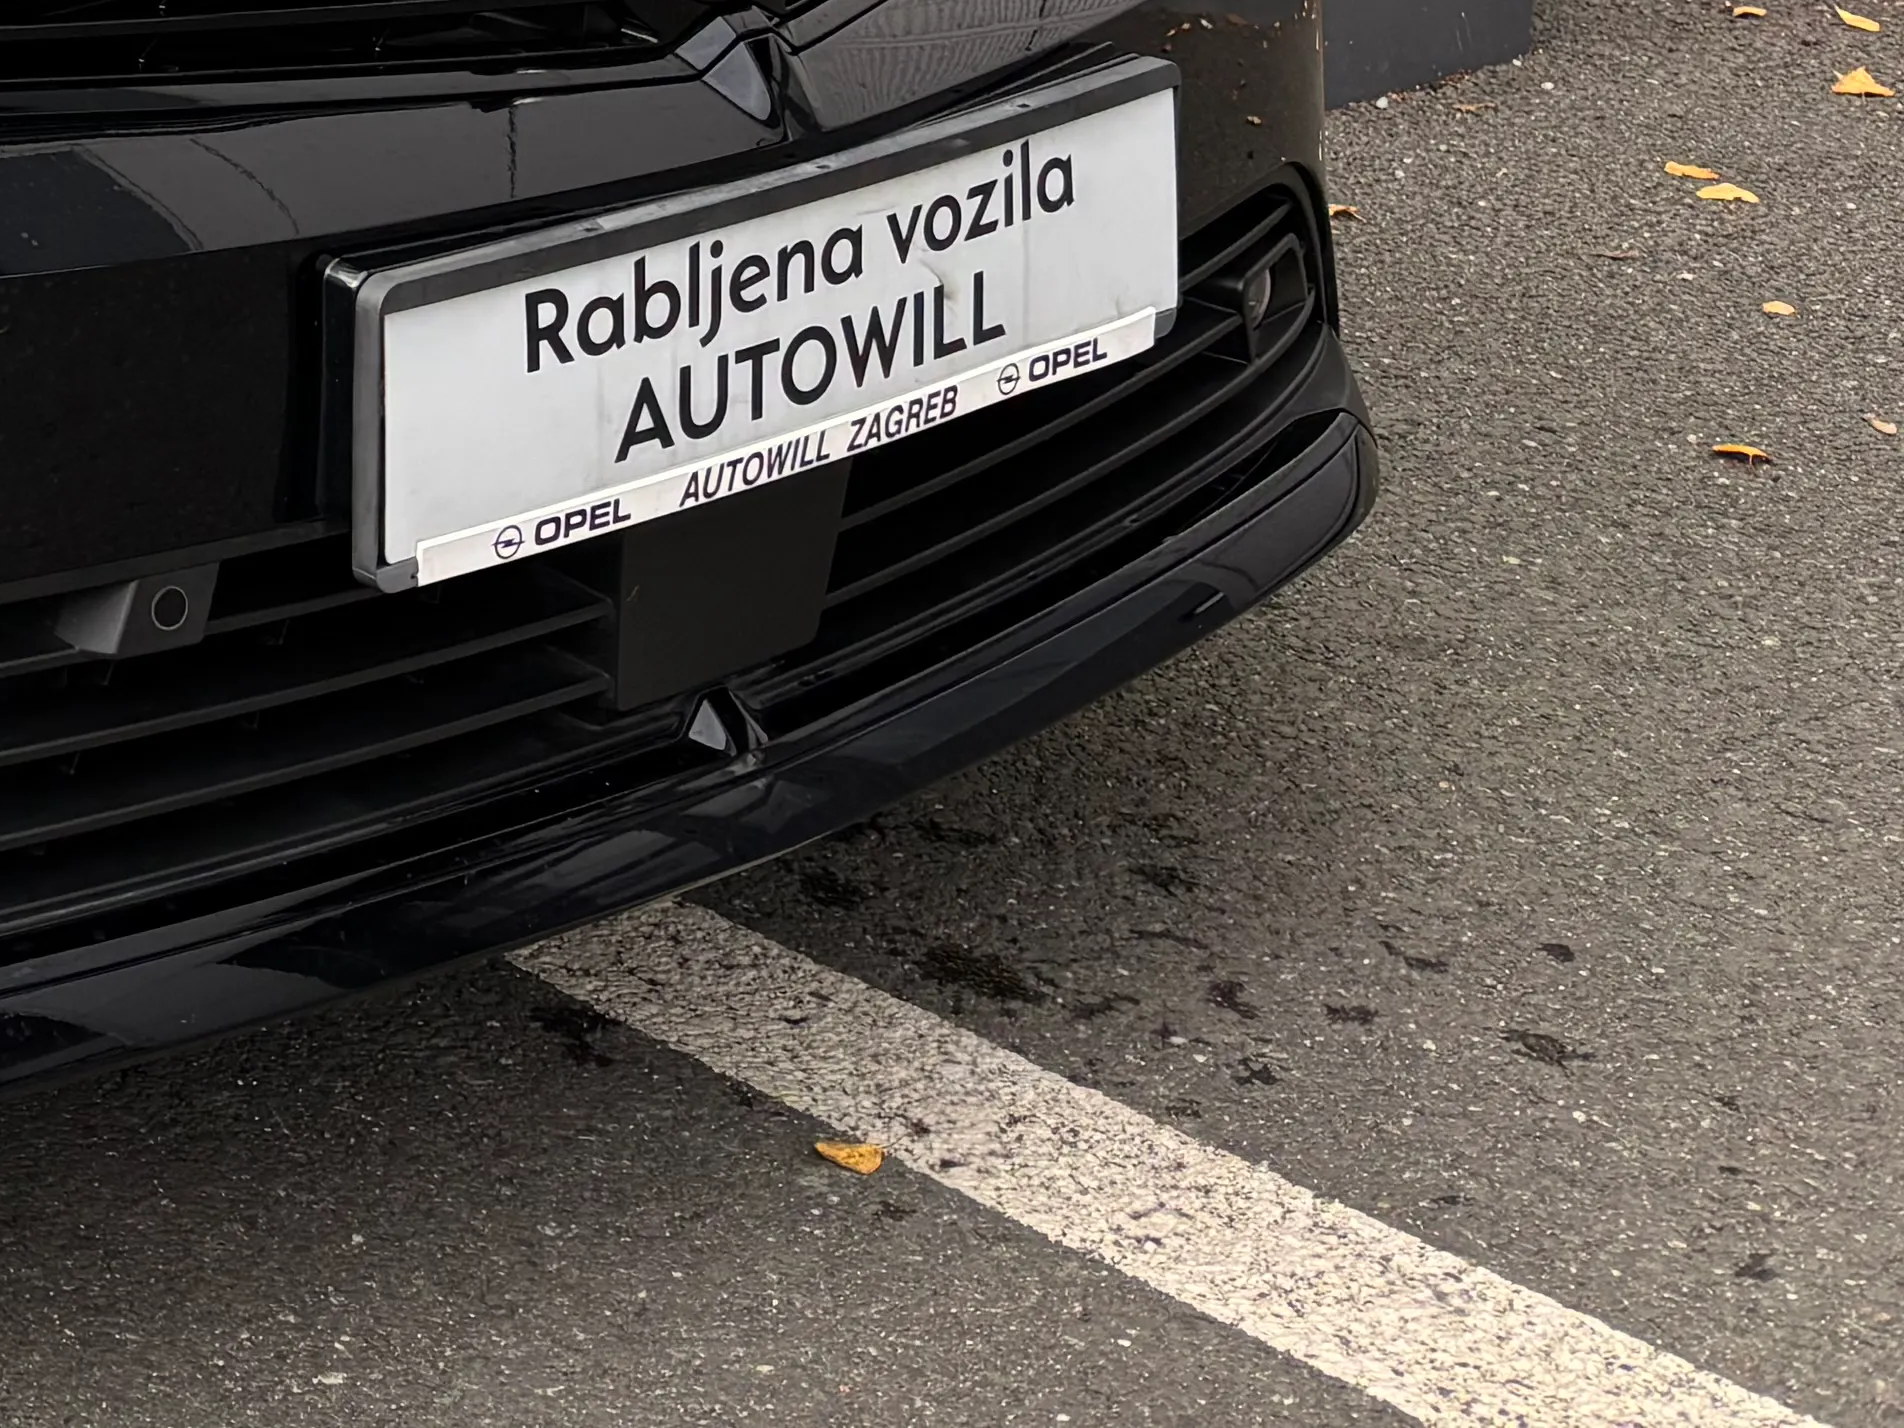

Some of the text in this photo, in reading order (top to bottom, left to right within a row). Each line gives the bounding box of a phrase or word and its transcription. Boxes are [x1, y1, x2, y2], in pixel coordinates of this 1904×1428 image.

[524, 138, 1075, 374] Rabljena vozila
[534, 336, 1108, 546] OPEL AUTOWILL ZAGREB OPEL
[614, 271, 1007, 465] AUTOWILL
